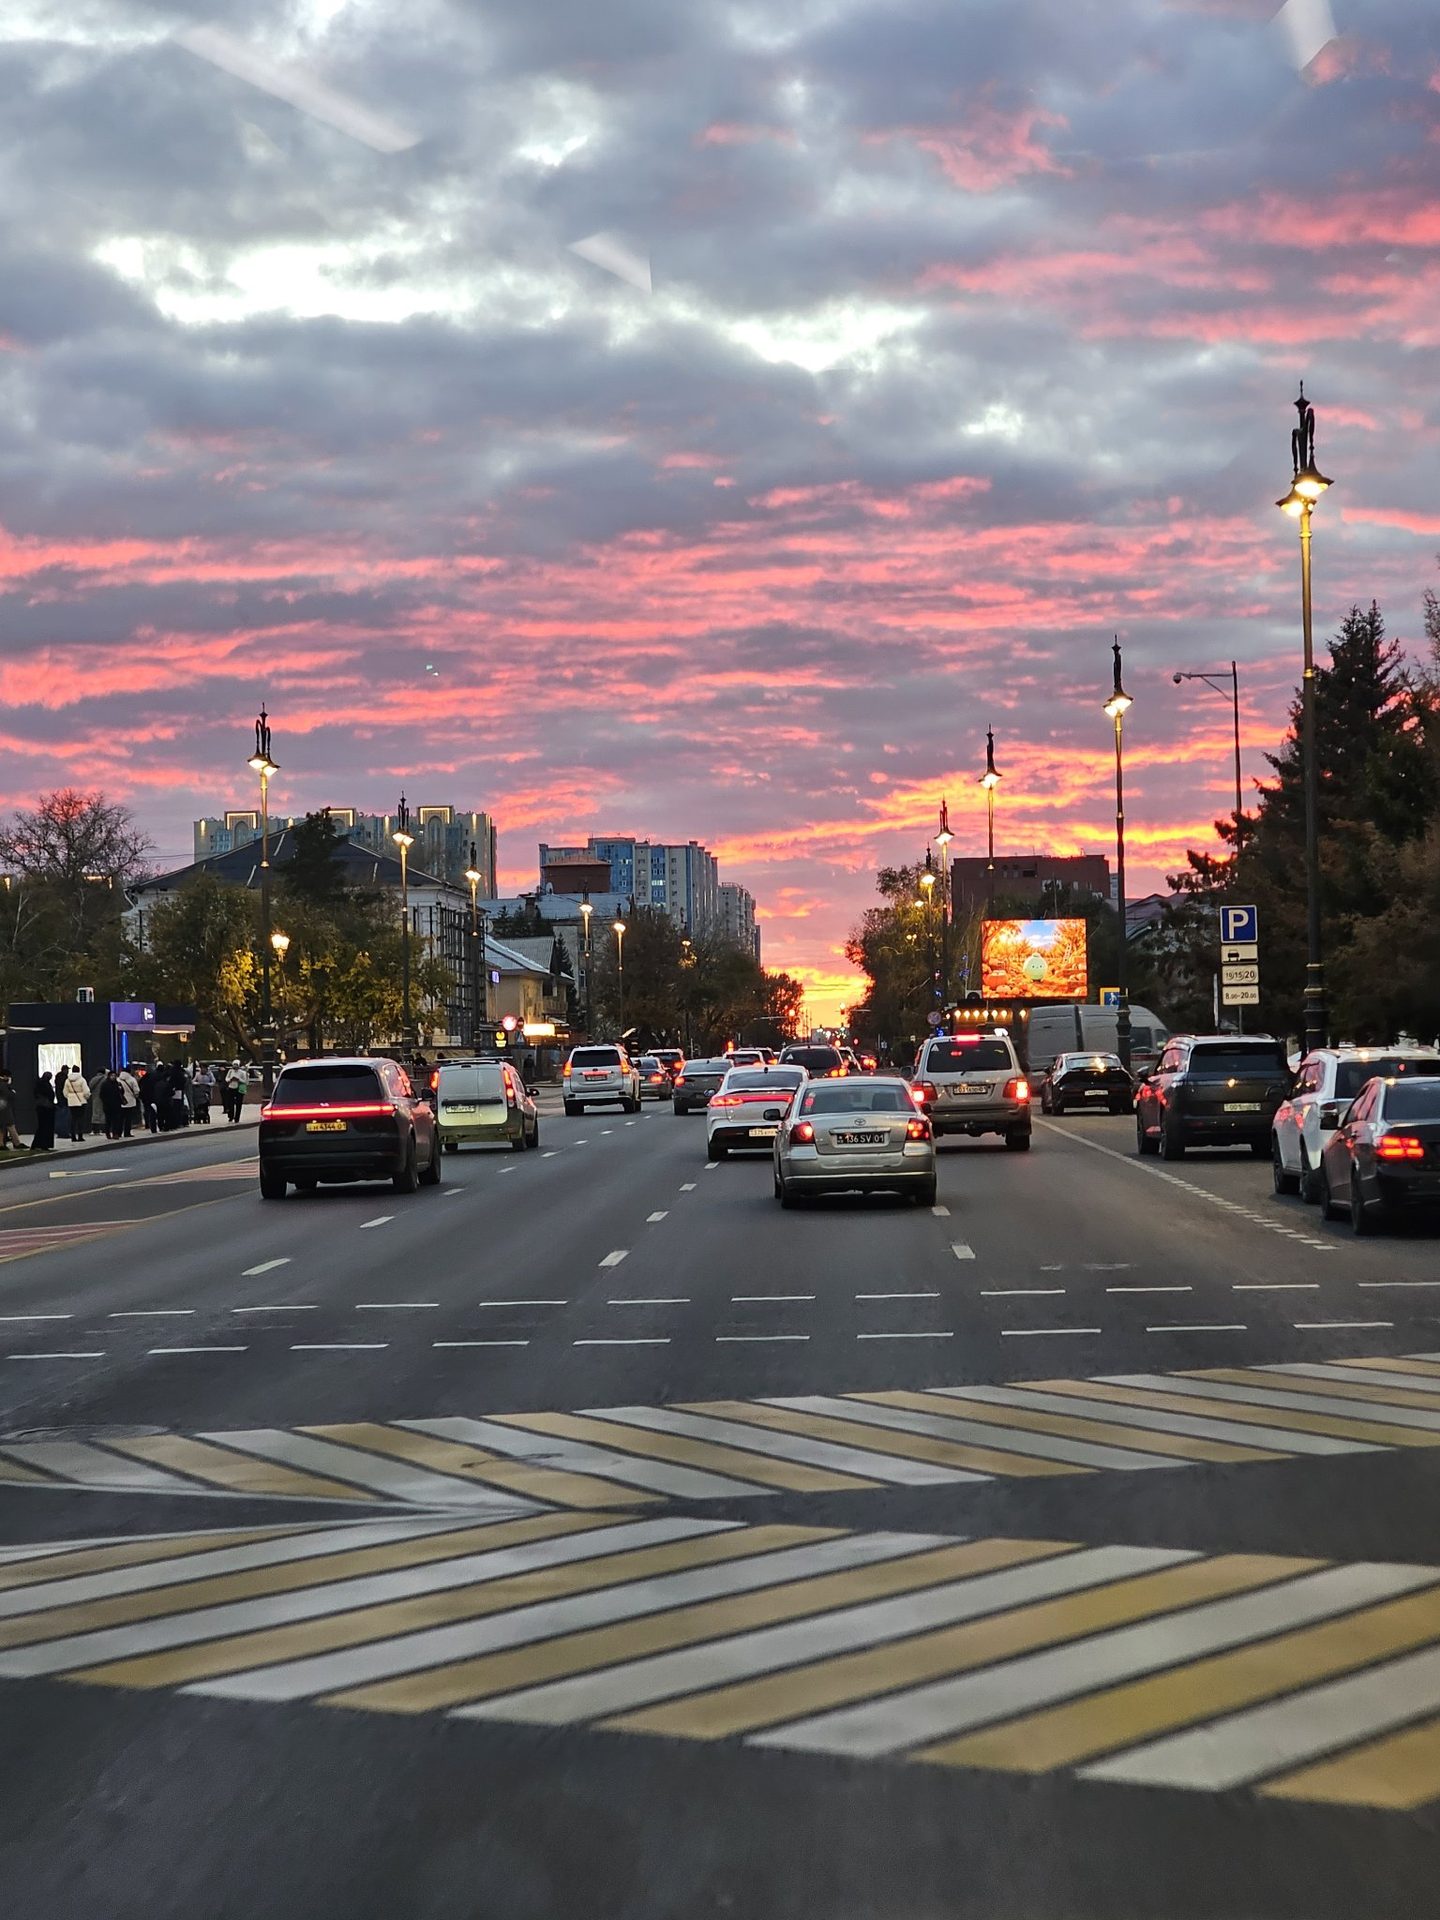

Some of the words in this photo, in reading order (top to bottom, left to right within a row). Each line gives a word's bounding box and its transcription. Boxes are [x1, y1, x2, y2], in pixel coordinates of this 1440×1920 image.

[1228, 909, 1249, 939] P
[844, 1134, 859, 1143] 136
[859, 1134, 872, 1143] SV
[874, 1134, 884, 1142] 01
